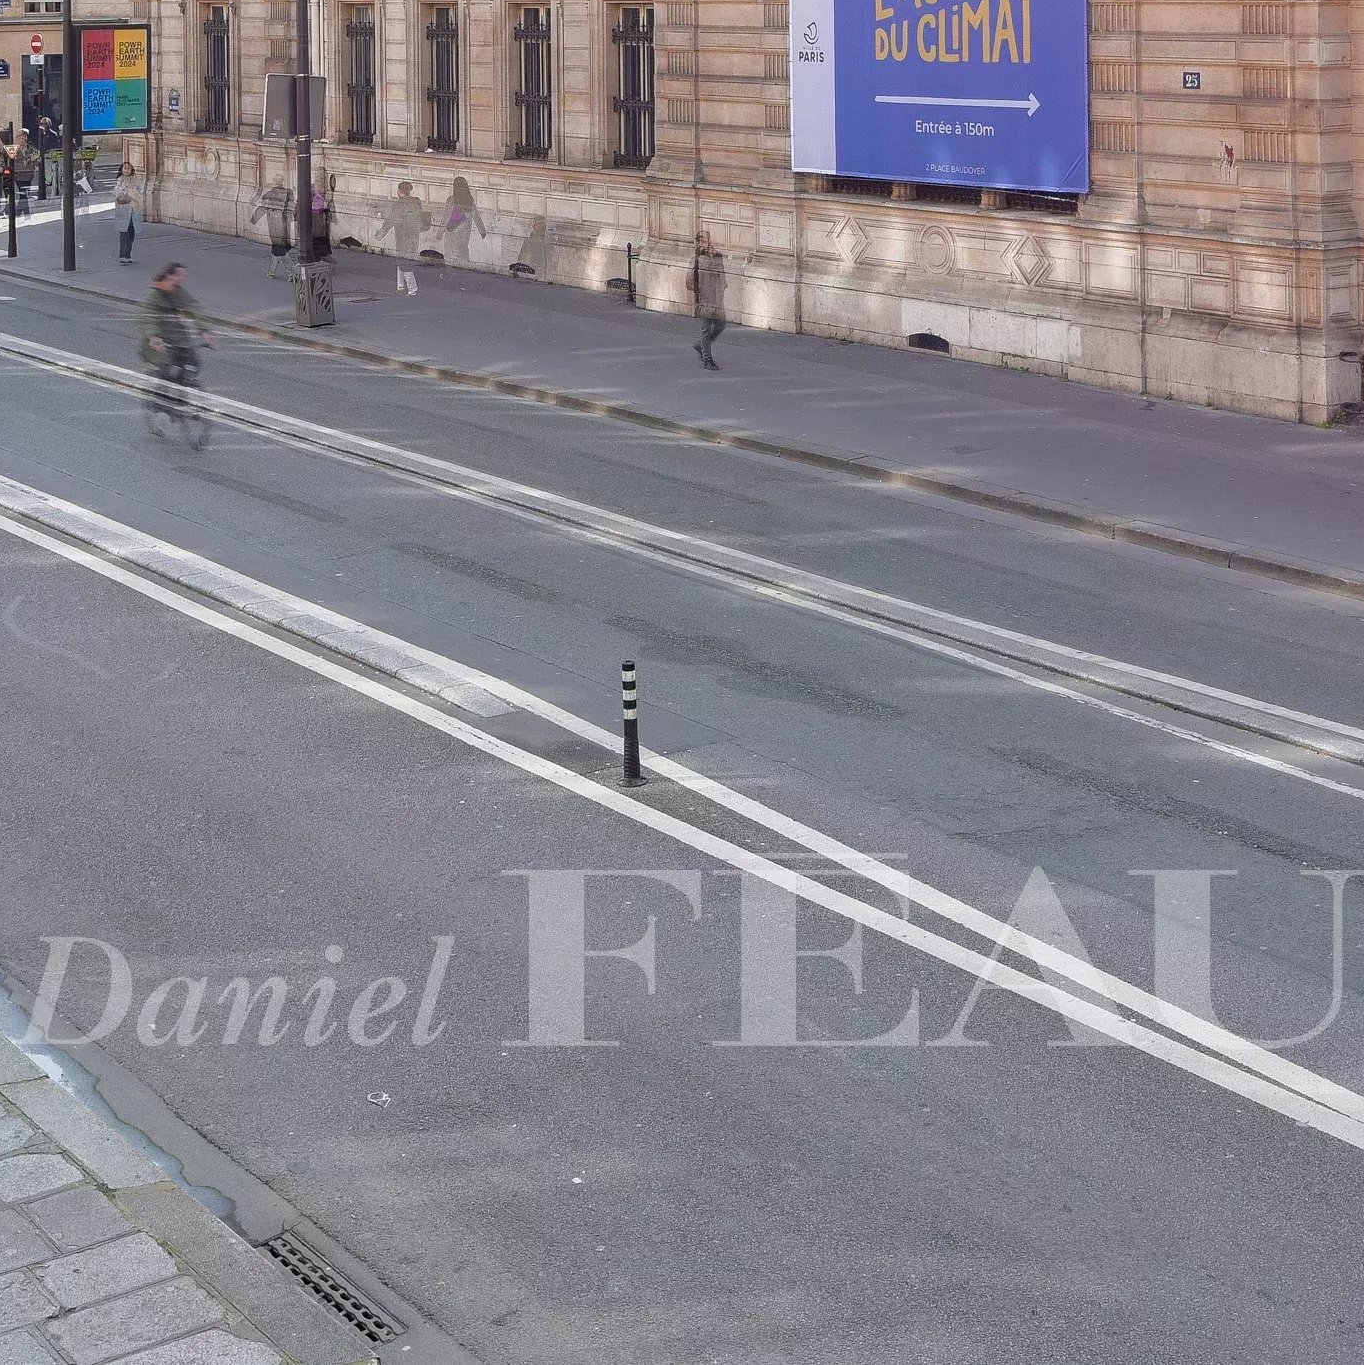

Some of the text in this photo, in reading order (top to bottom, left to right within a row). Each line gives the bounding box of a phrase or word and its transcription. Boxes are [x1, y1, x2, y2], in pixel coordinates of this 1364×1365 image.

[875, 20, 908, 62] DU
[798, 51, 824, 62] PARIS
[1184, 73, 1199, 87] 25
[84, 101, 112, 109] SUMMIT
[915, 120, 995, 136] Entrée à 150m
[930, 164, 950, 172] PLACE
[950, 165, 986, 175] BAUDOYER
